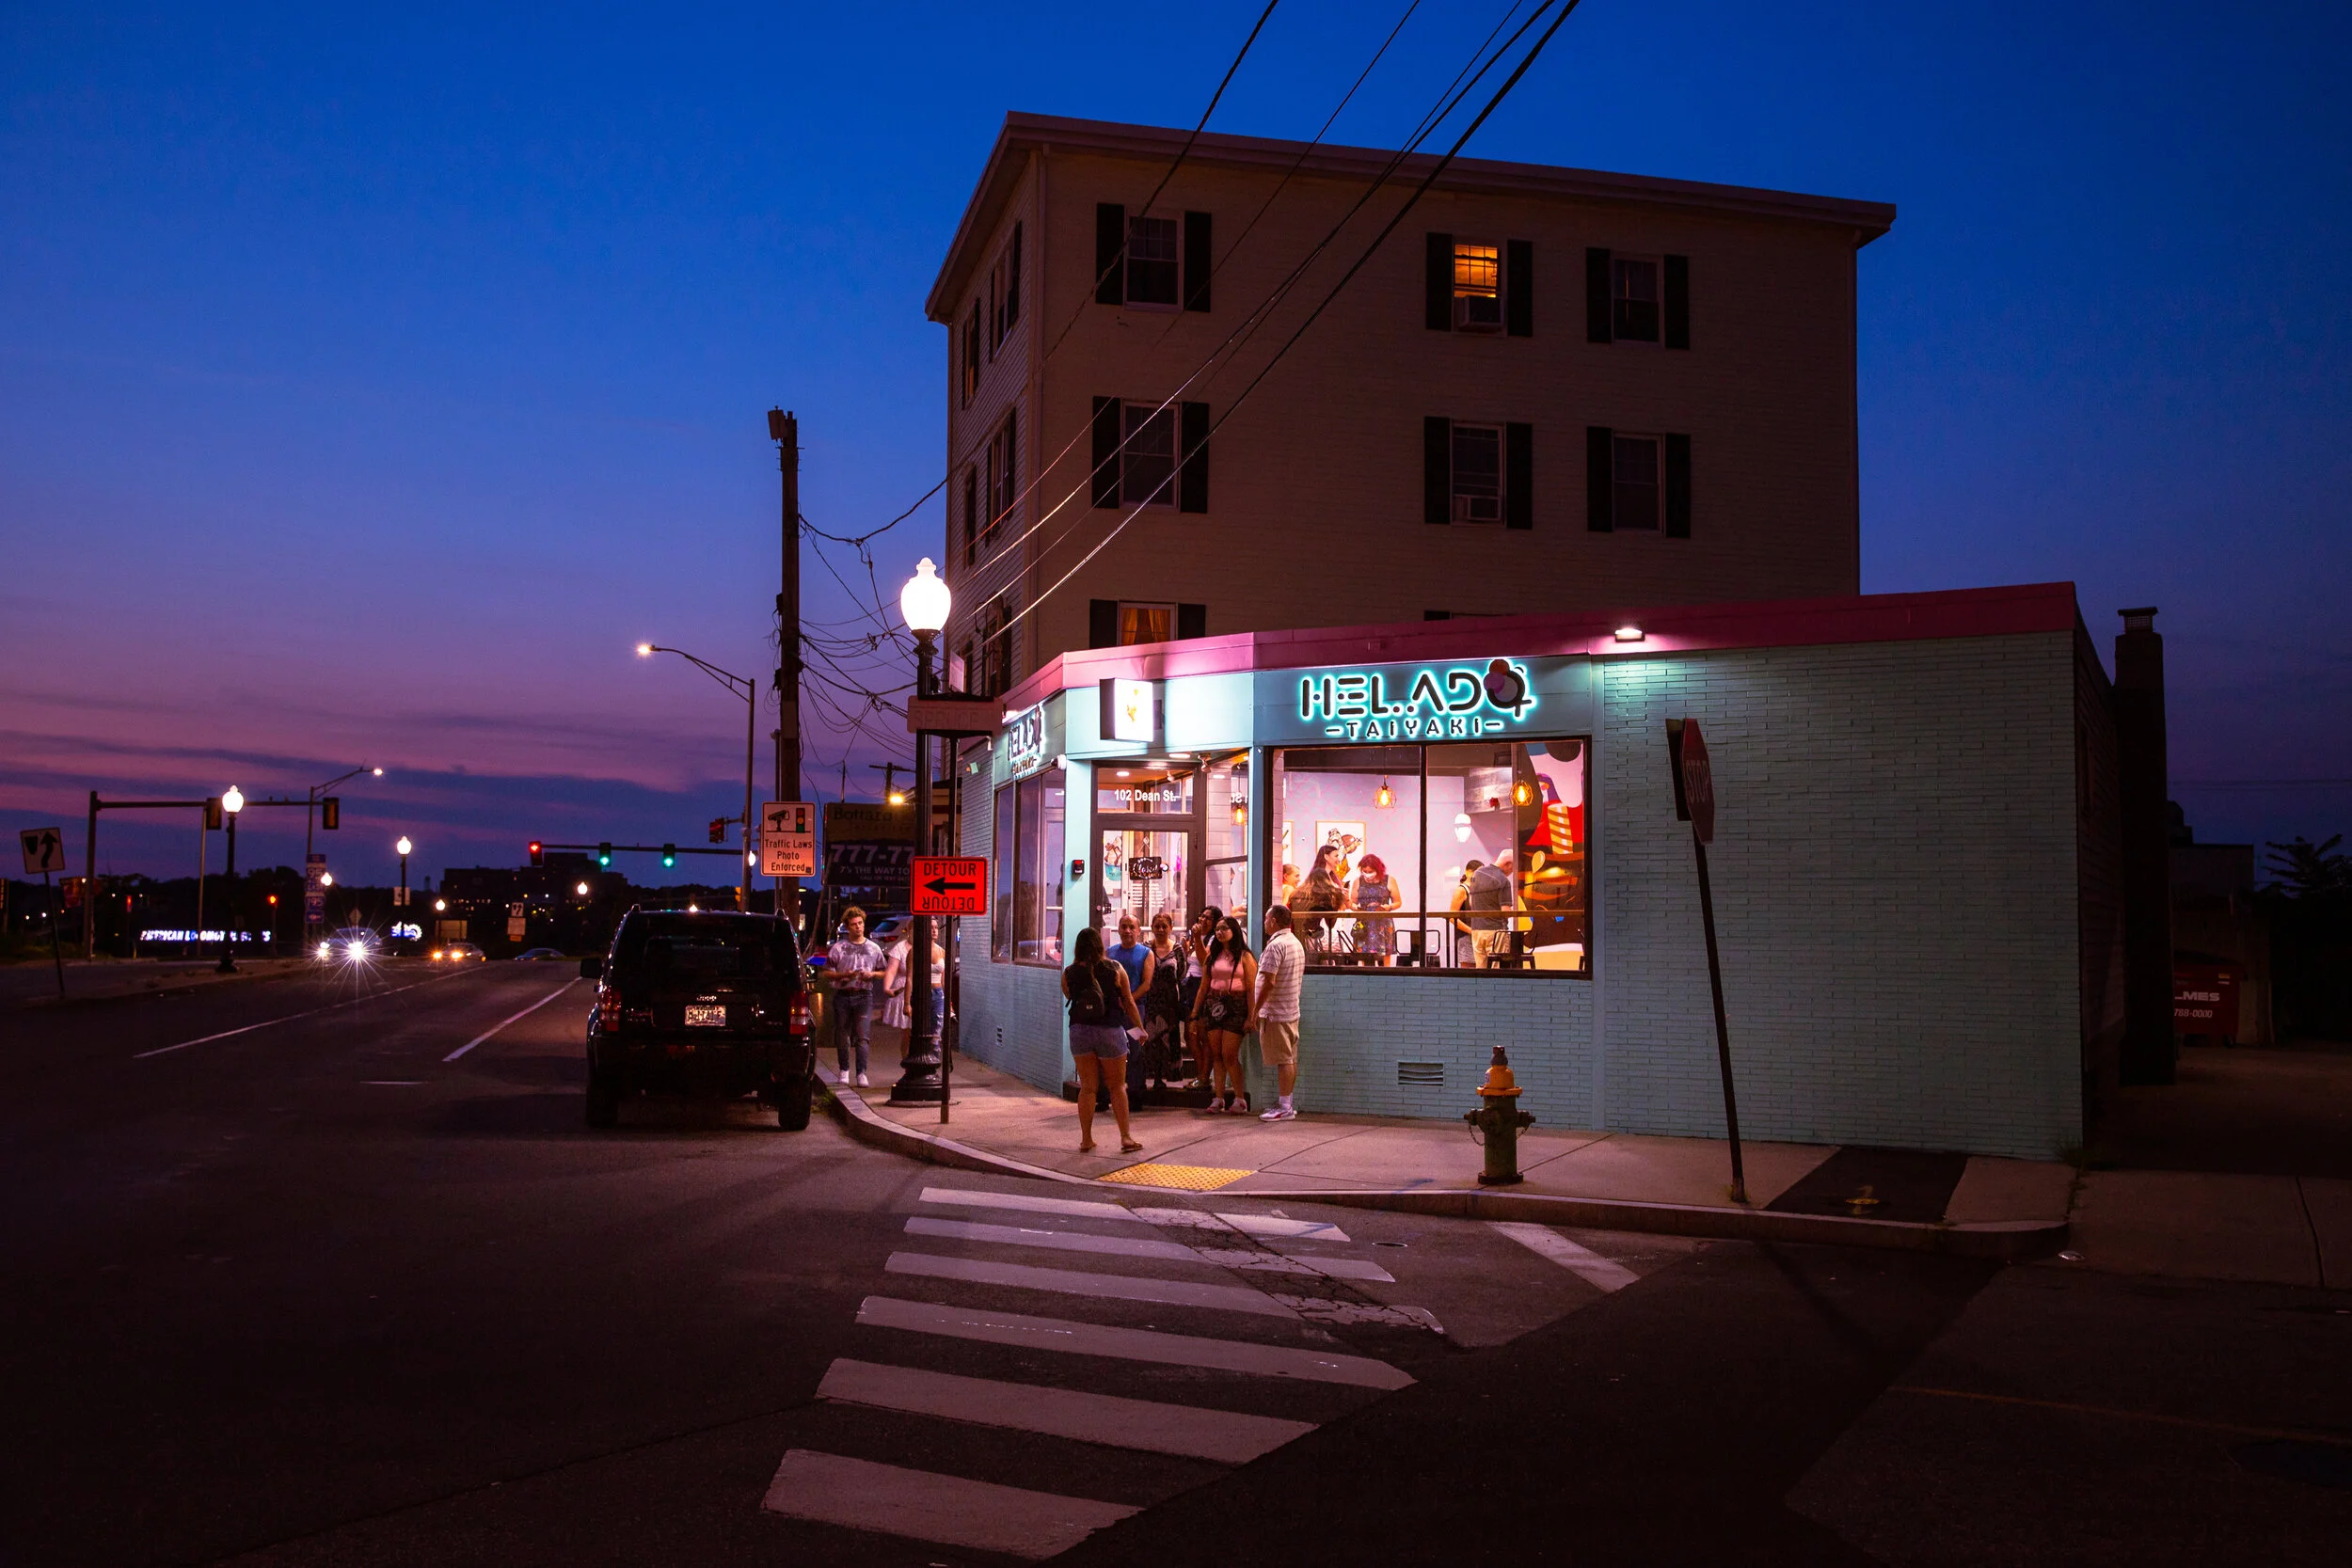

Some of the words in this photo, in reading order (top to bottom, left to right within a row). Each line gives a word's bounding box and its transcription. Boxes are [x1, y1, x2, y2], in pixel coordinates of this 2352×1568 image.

[1301, 662, 1531, 718] HELADO
[1686, 759, 1709, 804] STOP
[1114, 789, 1132, 801] 102
[1135, 789, 1161, 801] Dean
[1163, 790, 1177, 802] St.
[765, 839, 790, 848] Traffic
[793, 839, 813, 848] Laws
[777, 850, 800, 860] Photo
[771, 862, 805, 871] Enforced
[874, 866, 895, 875] WAY
[923, 863, 977, 877] DETOUR
[922, 895, 975, 911] DETOUR
